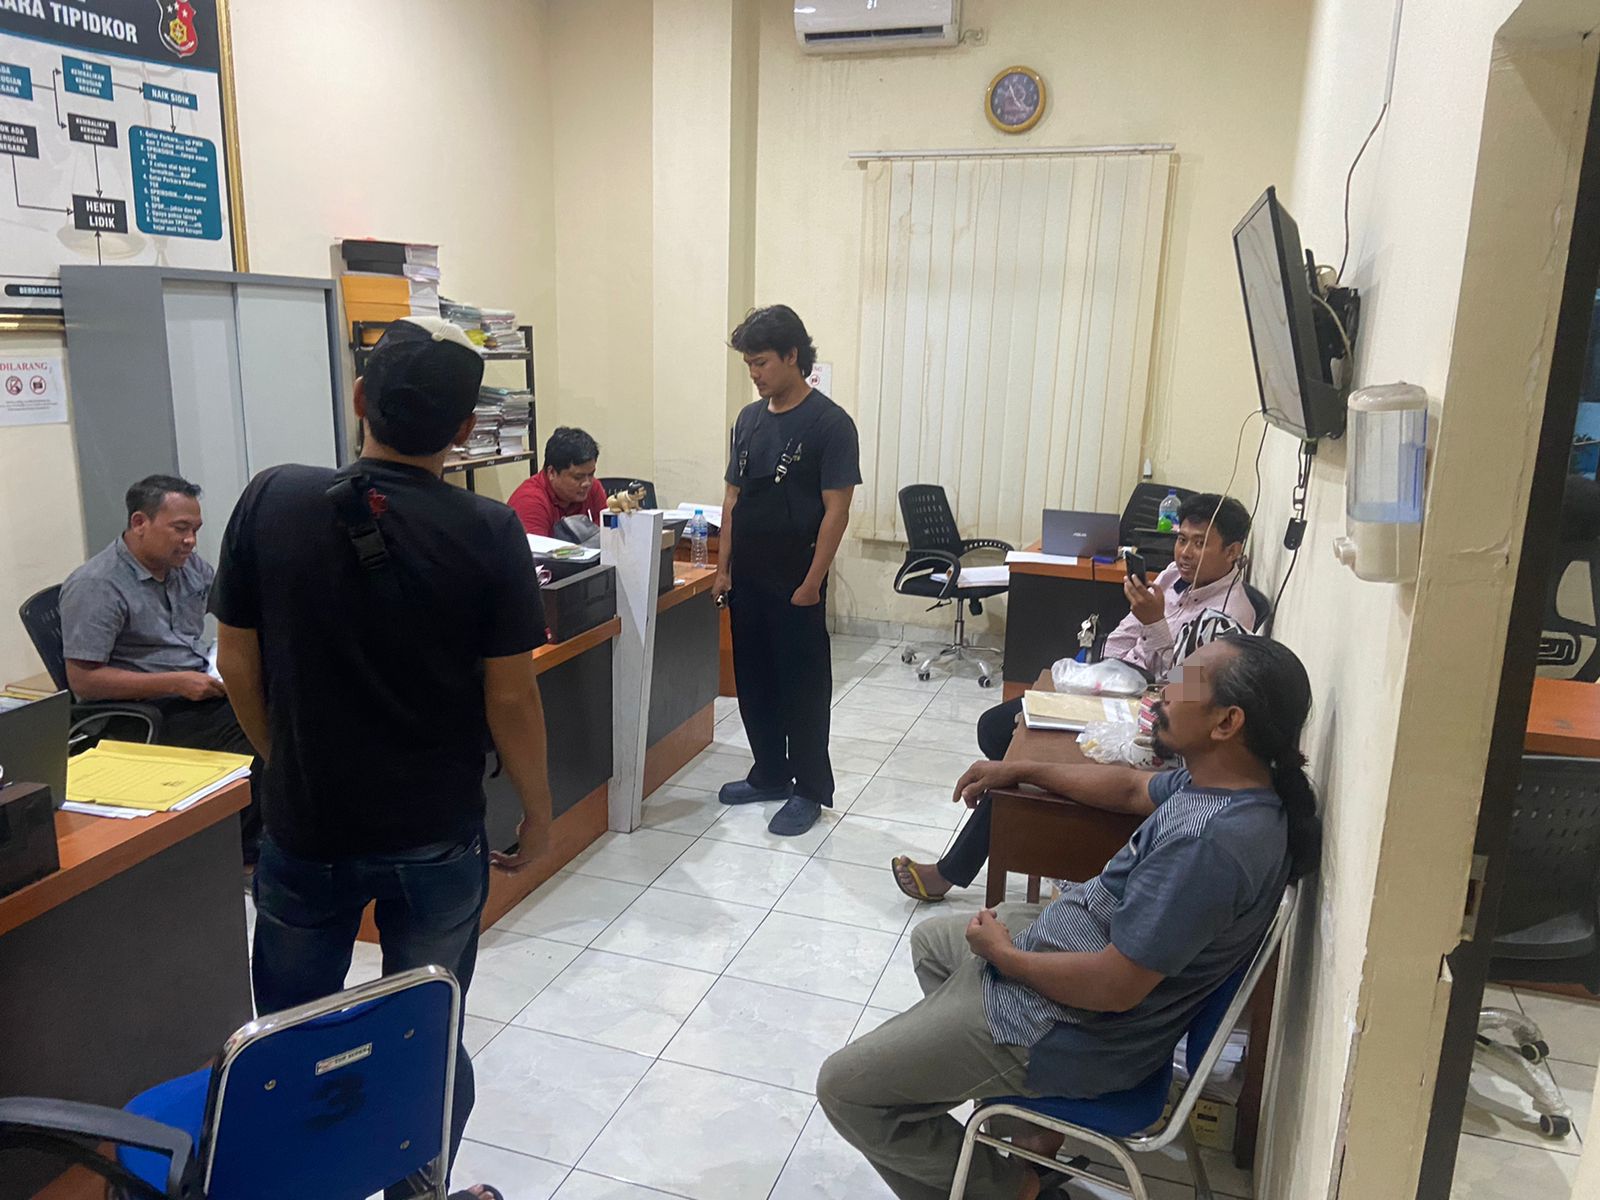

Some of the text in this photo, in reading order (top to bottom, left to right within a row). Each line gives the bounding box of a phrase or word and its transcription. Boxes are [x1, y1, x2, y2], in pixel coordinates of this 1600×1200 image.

[0, 0, 138, 44] ARA TIPIDKOR
[151, 88, 190, 106] NAIK SIDIK
[11, 126, 25, 135] ADA
[85, 200, 115, 214] HENTI
[89, 216, 115, 228] LIDIK
[19, 286, 61, 295] BERDASARKA
[0, 362, 48, 371] DILARANG
